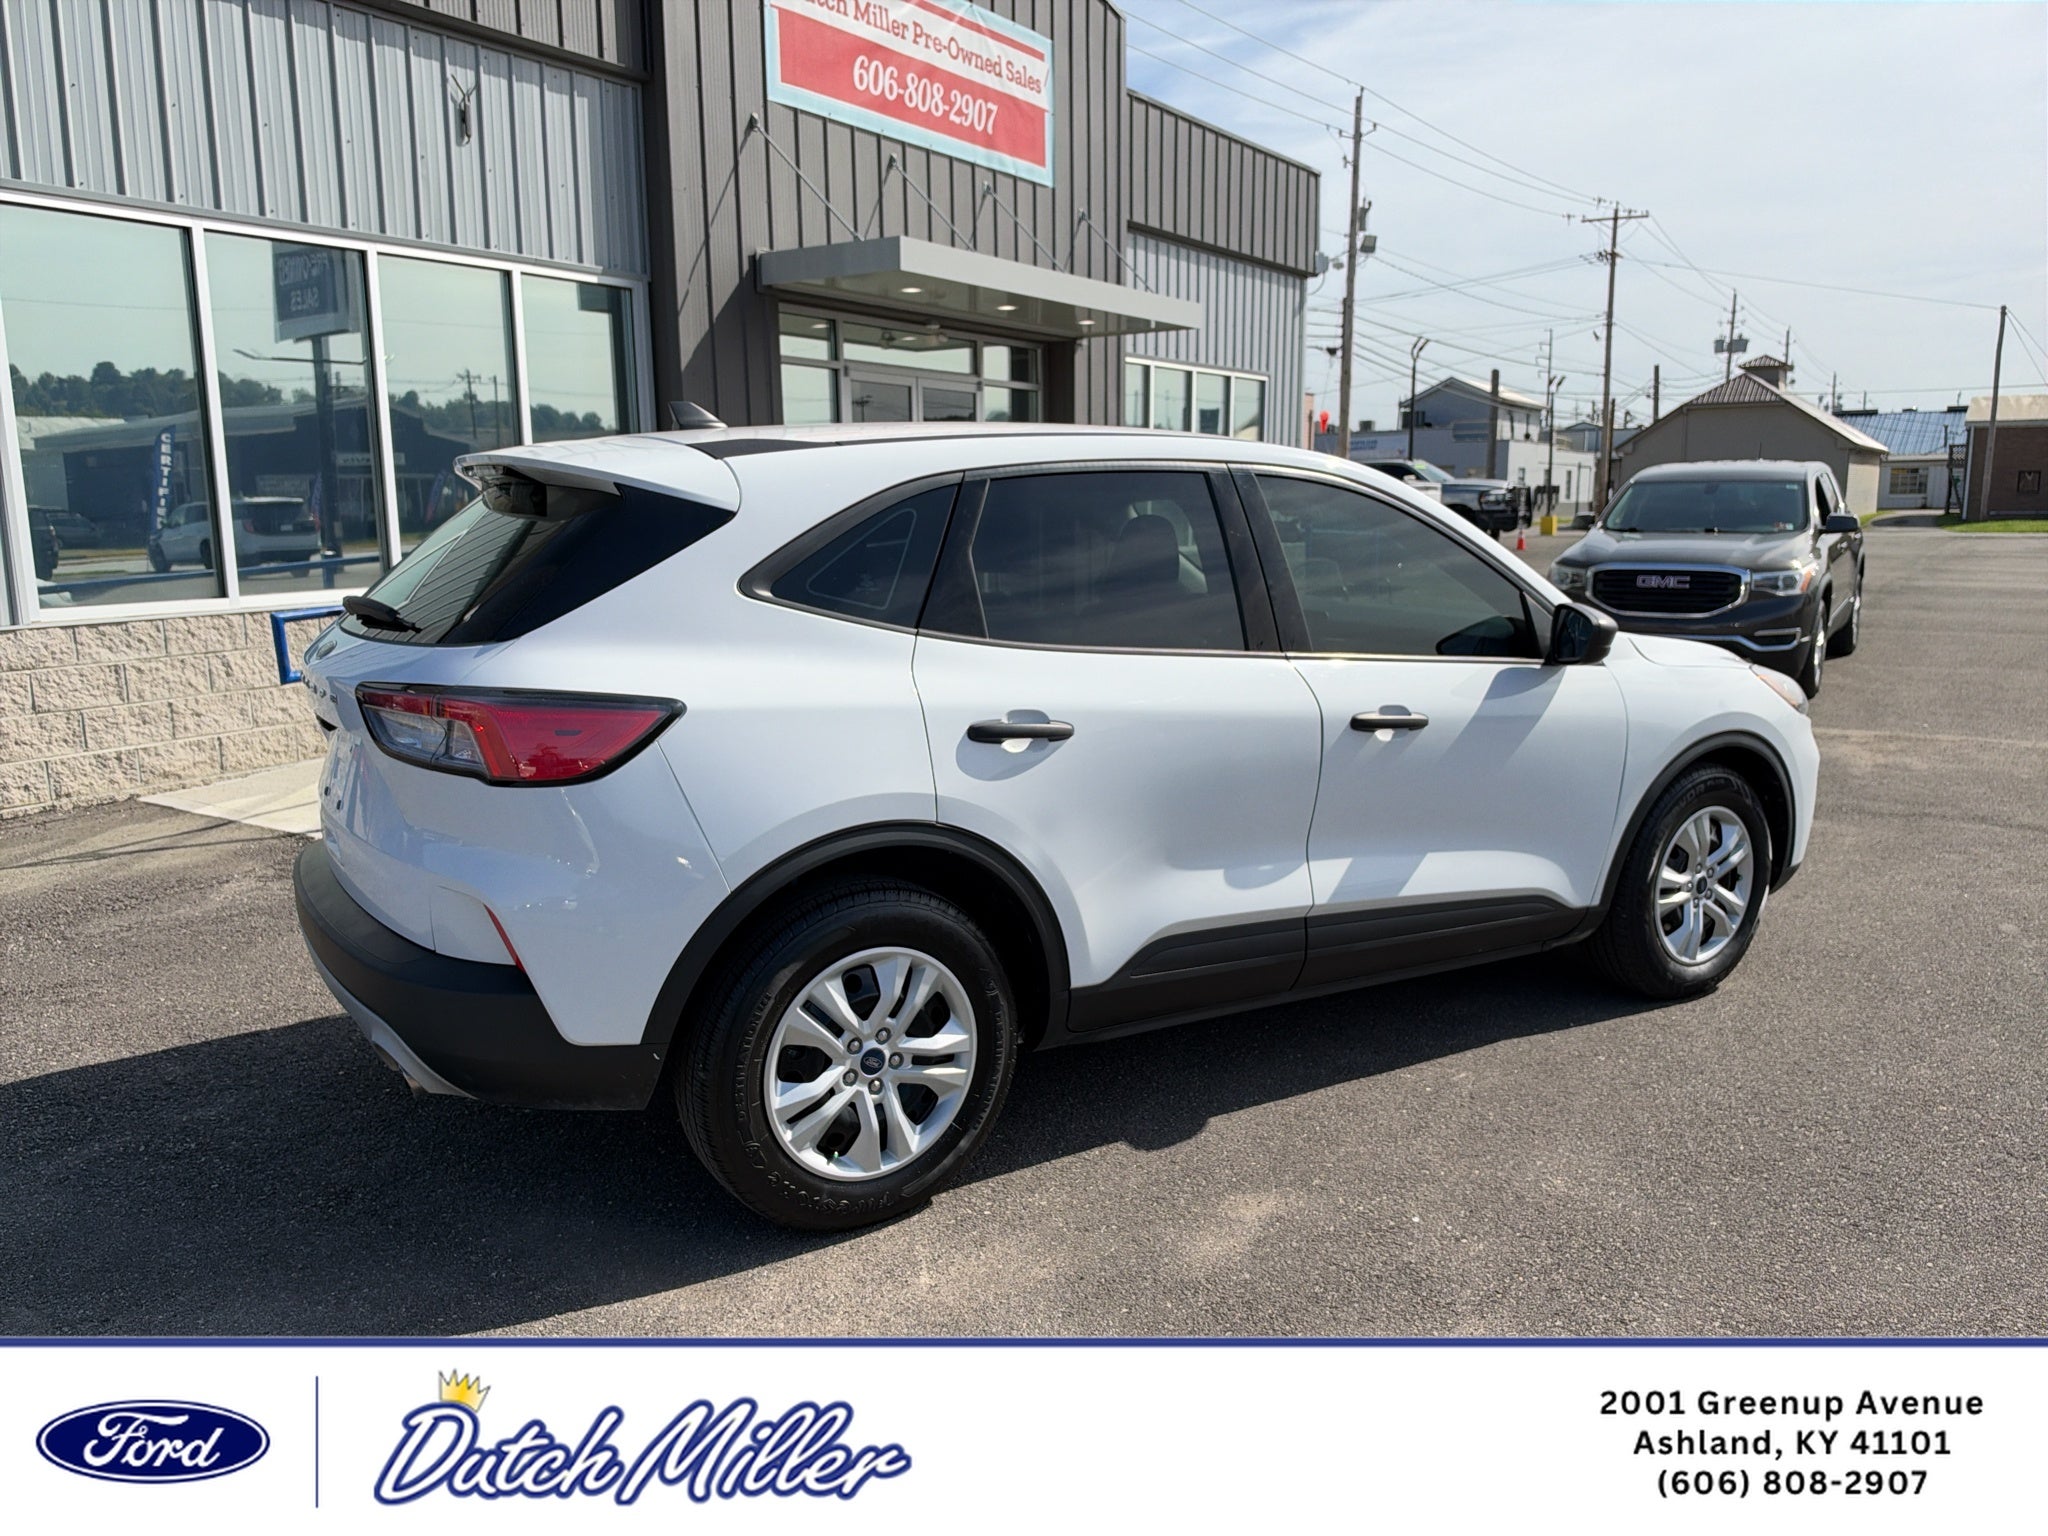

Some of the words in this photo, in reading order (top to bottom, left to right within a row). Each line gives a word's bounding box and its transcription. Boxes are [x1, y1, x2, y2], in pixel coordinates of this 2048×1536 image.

[853, 0, 909, 40] Miller
[912, 20, 1003, 77] Pre-Owned
[1006, 61, 1042, 94] Sales
[853, 54, 999, 135] 606-808-2907
[1636, 574, 1691, 589] GMC
